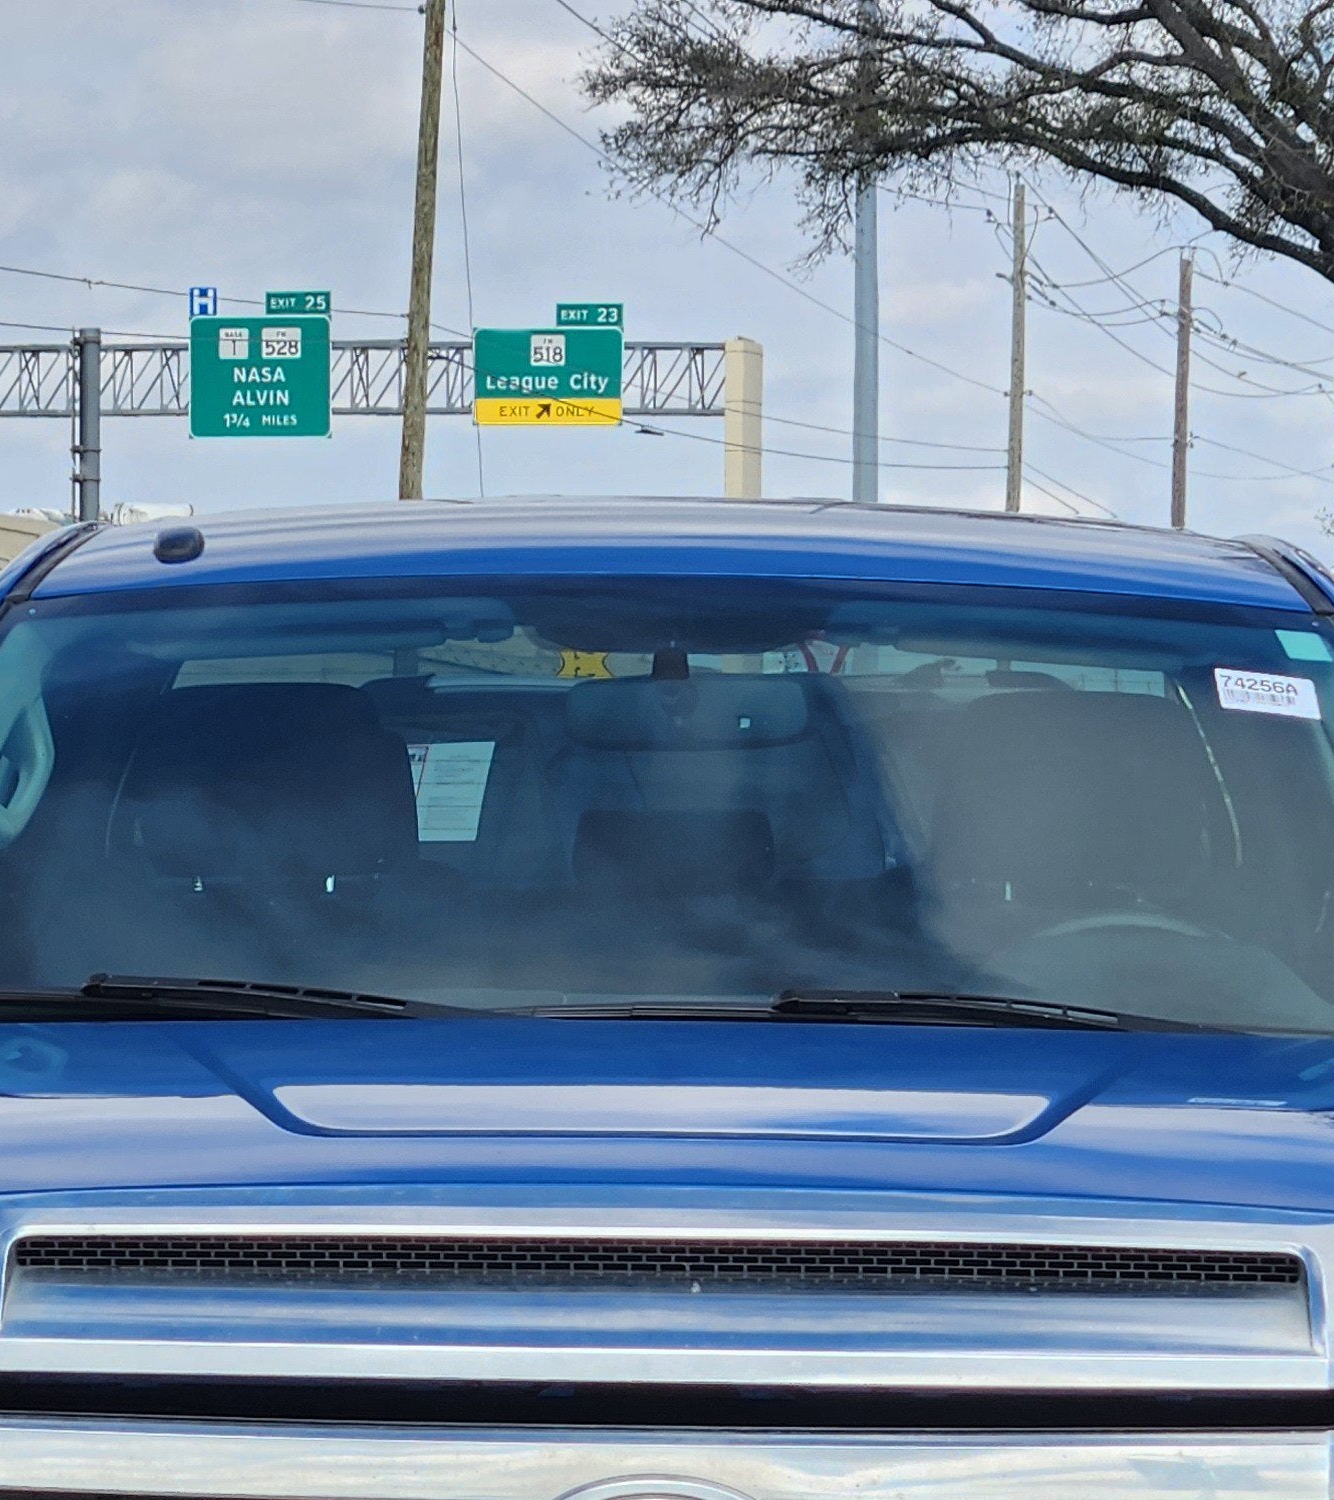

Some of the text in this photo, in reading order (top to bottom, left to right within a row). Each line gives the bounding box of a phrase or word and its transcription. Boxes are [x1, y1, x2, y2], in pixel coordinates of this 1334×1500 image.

[192, 288, 215, 315] H
[269, 295, 327, 311] EXIT 25
[560, 307, 618, 322] EXIT 23
[264, 340, 299, 356] 528
[533, 346, 563, 362] 518
[233, 366, 286, 383] NASA
[486, 372, 609, 394] League City
[232, 389, 289, 406] ALVIN
[499, 406, 595, 417] EXIT ONLY
[261, 414, 298, 426] MILES
[1220, 675, 1298, 696] 74256A
